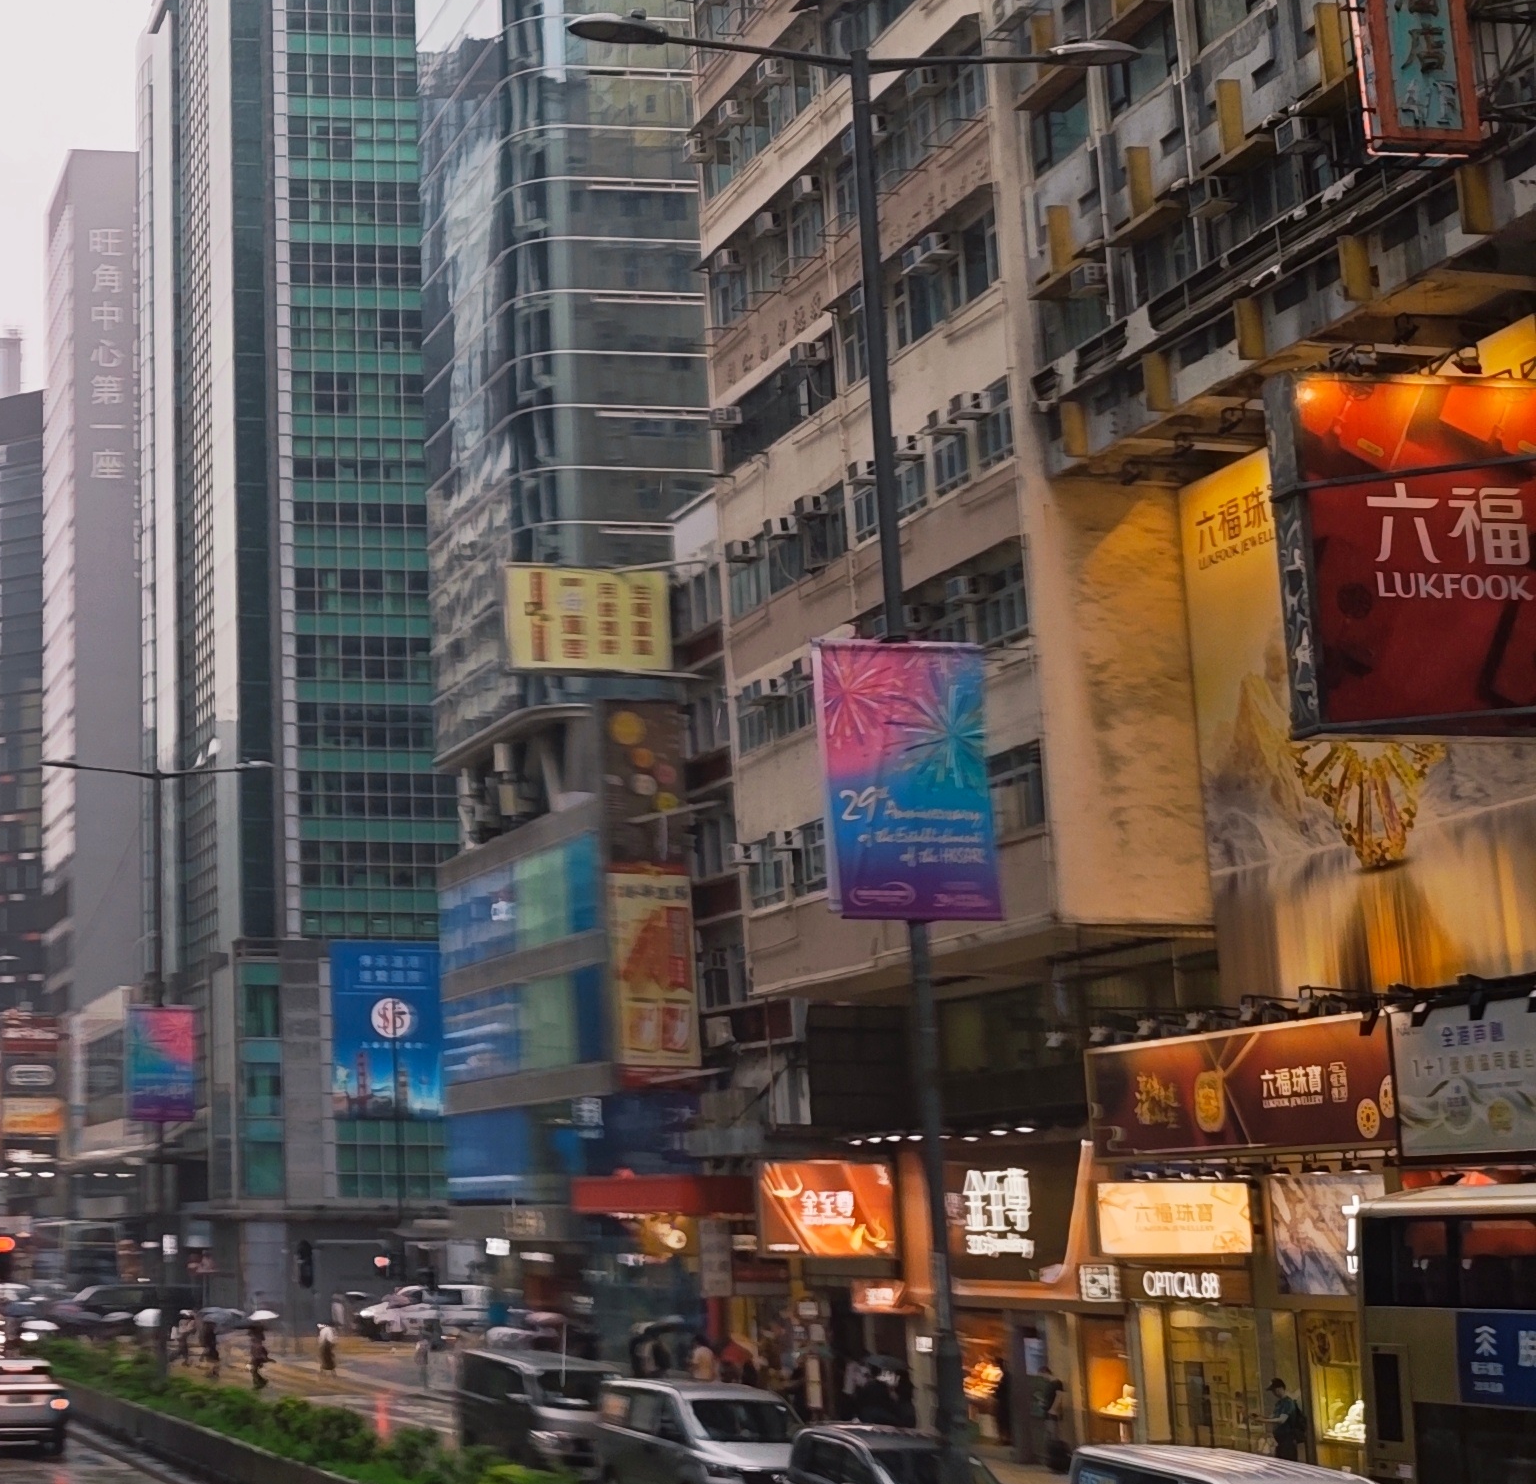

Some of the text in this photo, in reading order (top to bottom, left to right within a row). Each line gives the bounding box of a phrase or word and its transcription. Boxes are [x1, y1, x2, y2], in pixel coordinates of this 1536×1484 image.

[88, 227, 126, 480] 旺角中心第一座
[1366, 481, 1531, 567] 六福
[1375, 569, 1536, 603] LUKFOOK
[1260, 1065, 1323, 1098] 六福珠寶
[1133, 1203, 1214, 1223] 六福珠寶
